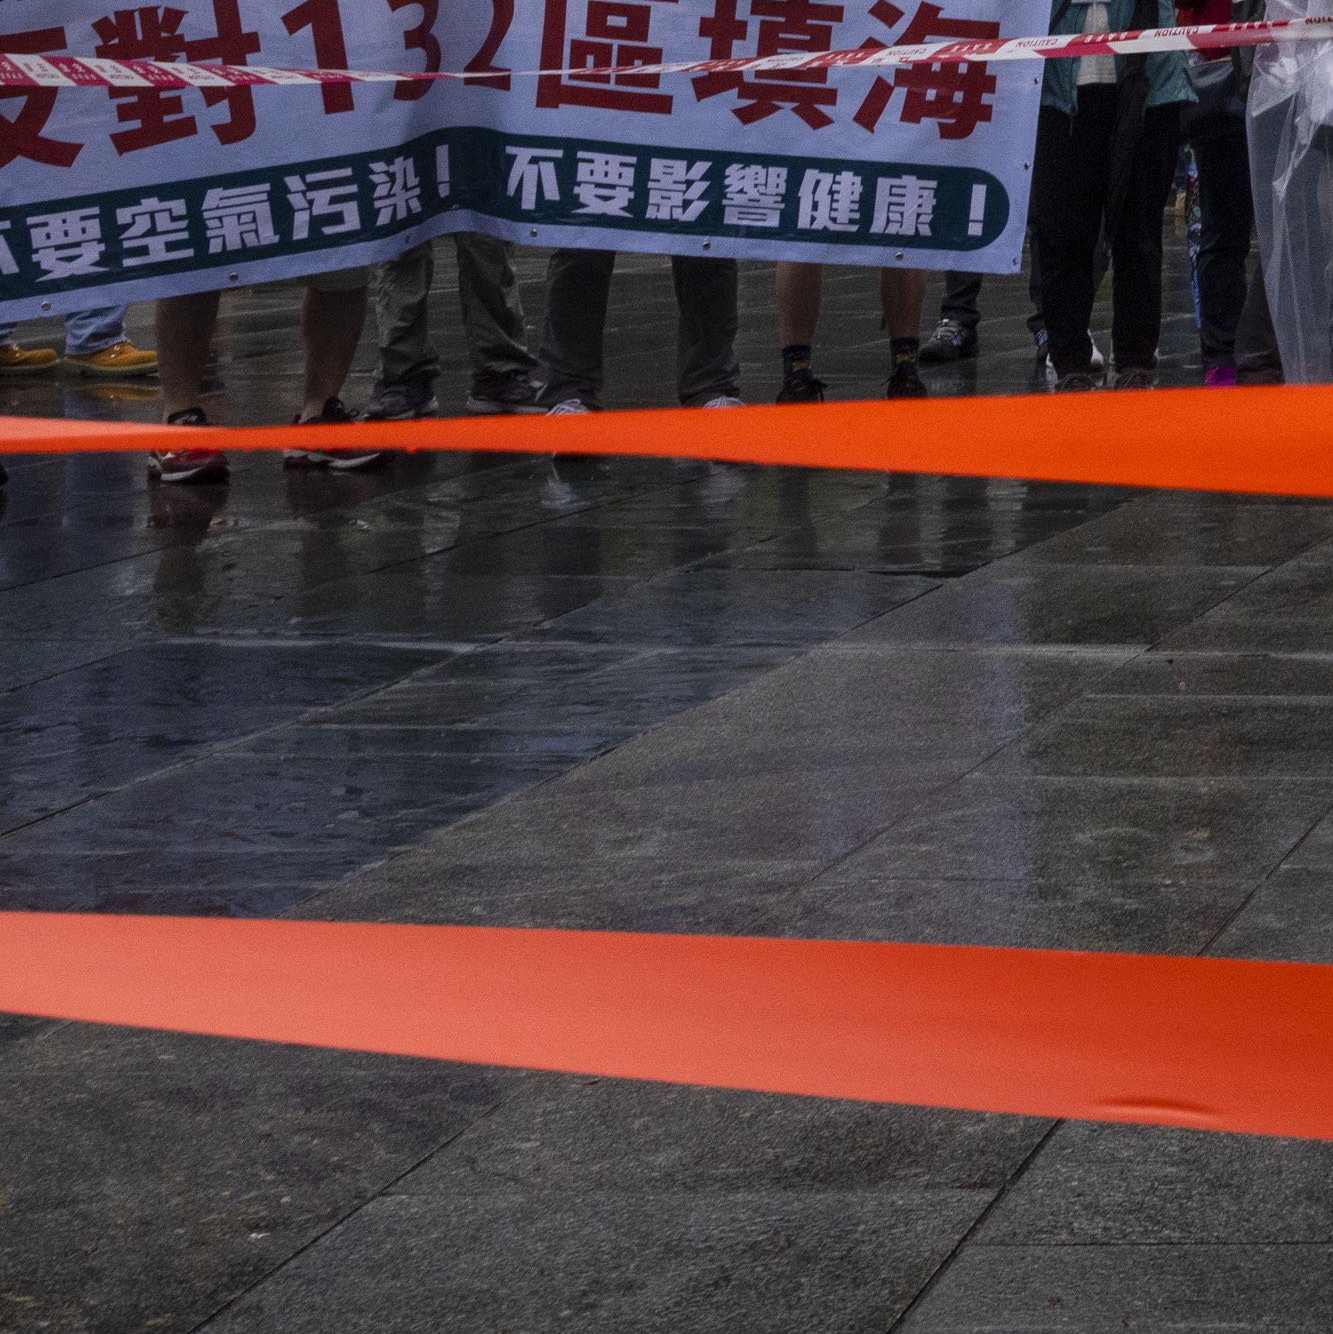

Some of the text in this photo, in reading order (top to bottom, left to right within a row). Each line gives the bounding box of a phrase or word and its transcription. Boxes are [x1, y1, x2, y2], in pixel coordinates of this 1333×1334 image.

[1084, 31, 1127, 43] SAFE
[1154, 25, 1199, 38] CAUTION
[951, 41, 992, 53] SAFE
[1016, 37, 1057, 48] CAUTION
